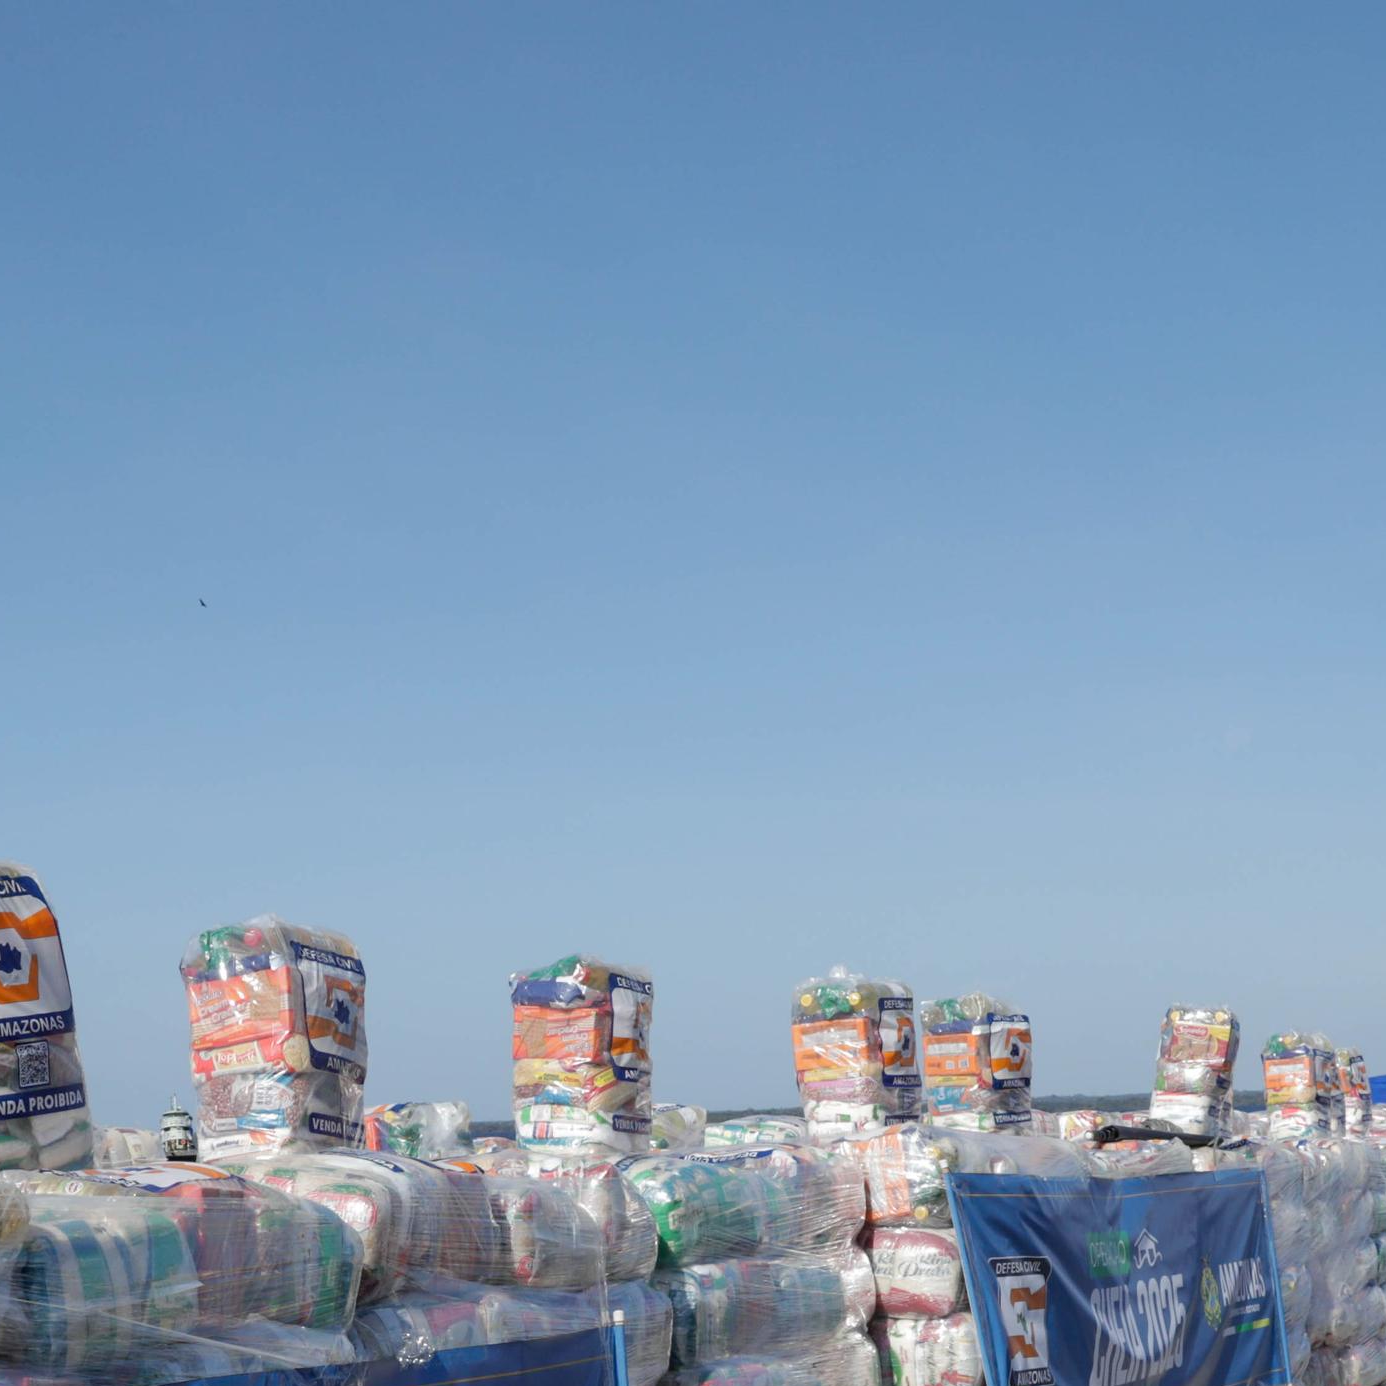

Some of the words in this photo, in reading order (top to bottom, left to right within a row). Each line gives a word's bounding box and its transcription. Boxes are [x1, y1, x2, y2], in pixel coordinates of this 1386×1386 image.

[28, 1089, 84, 1111] PROIBIDA
[312, 1117, 342, 1134] VENDA
[995, 1260, 1023, 1275] DEFESA
